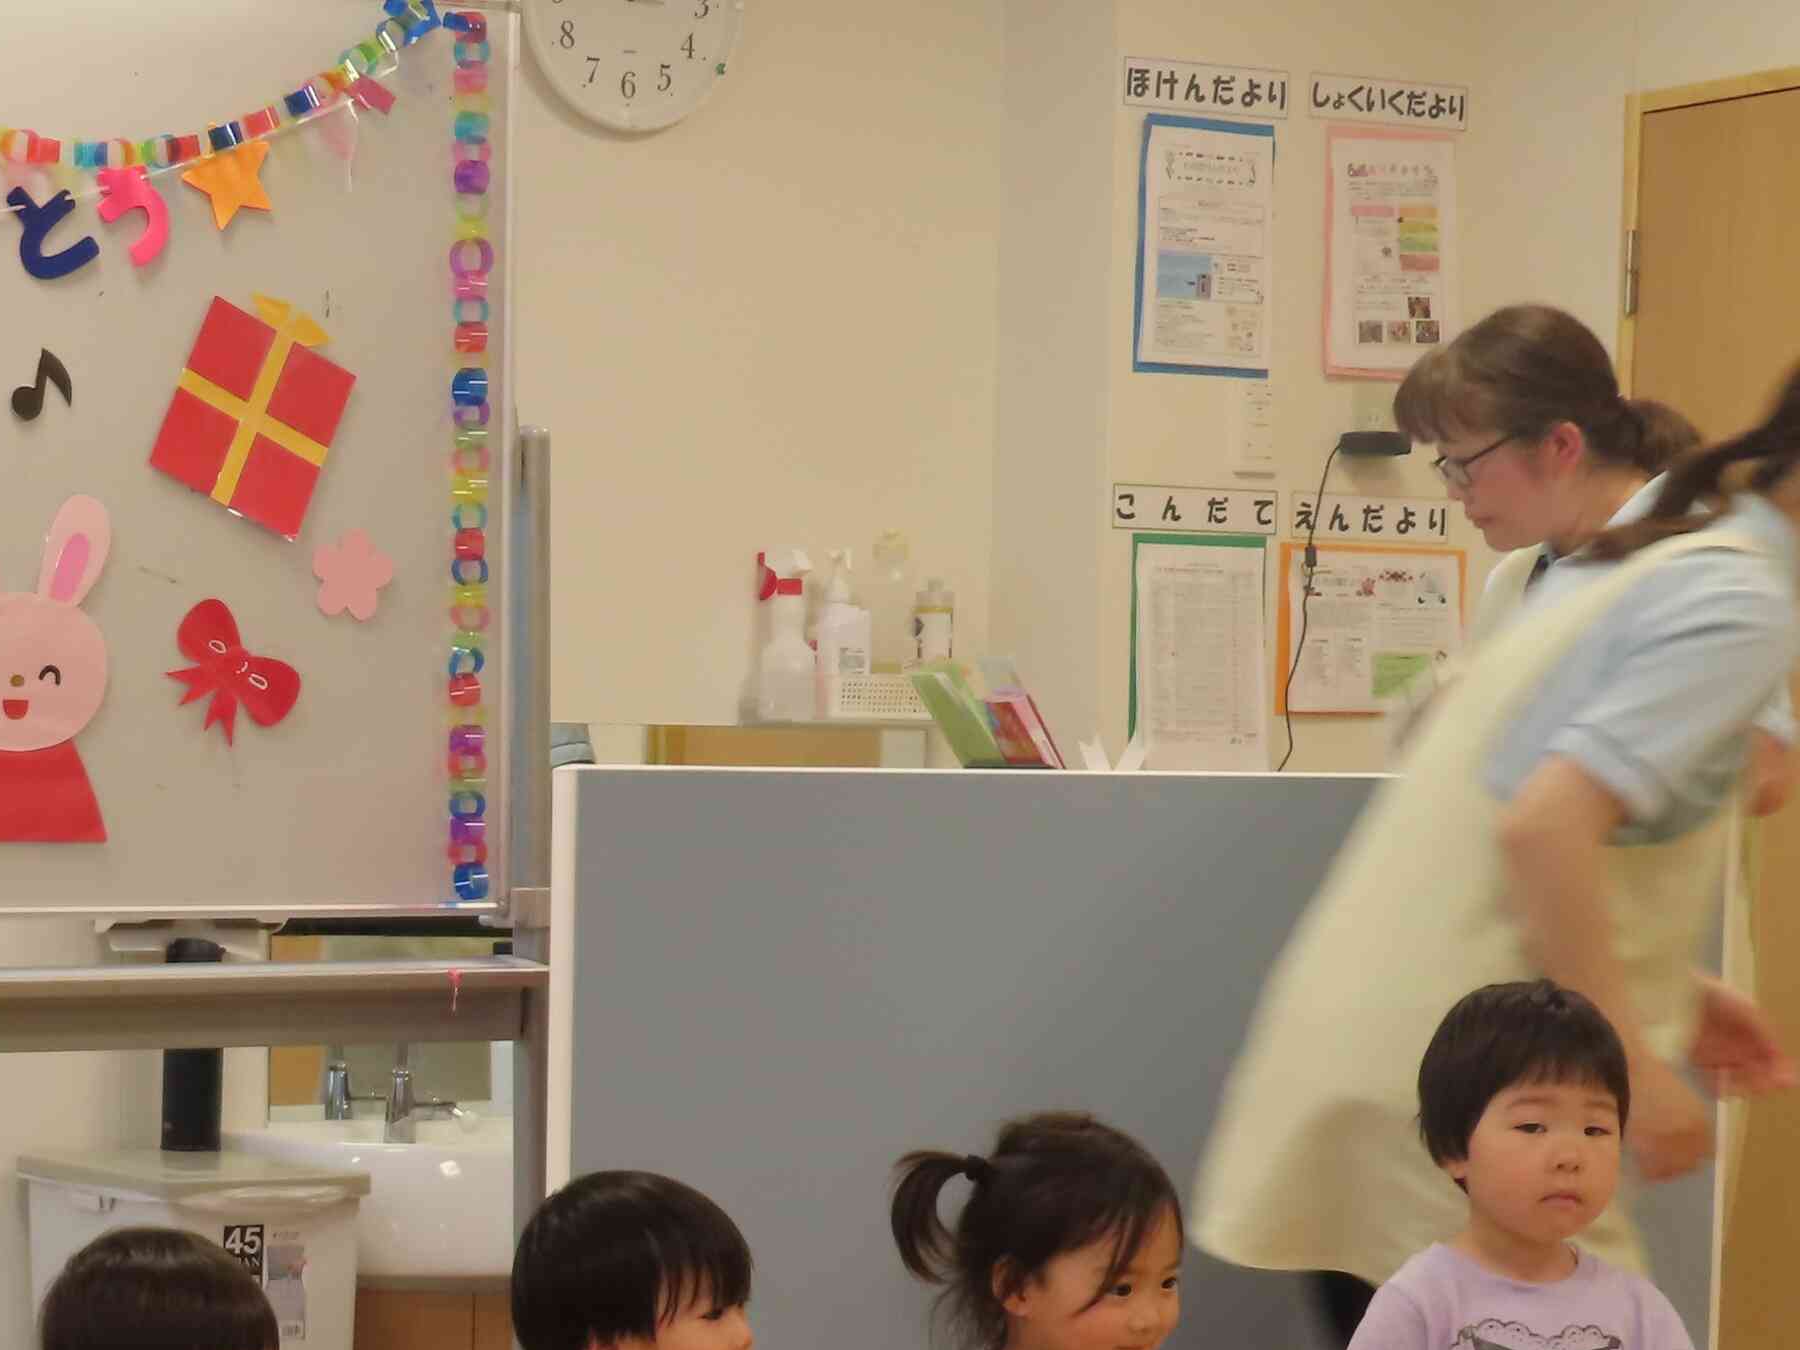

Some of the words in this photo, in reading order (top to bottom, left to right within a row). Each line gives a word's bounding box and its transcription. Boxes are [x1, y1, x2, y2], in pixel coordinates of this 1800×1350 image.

[560, 20, 575, 49] 8
[680, 33, 695, 59] 4
[586, 56, 600, 83] 7
[657, 64, 671, 92] 5
[621, 71, 636, 99] 6
[1126, 67, 1287, 110] ほけんだより
[1312, 81, 1465, 121] しょくいくだより
[1116, 494, 1274, 526] こんだて
[1295, 503, 1446, 536] えんだより
[225, 1227, 261, 1254] 45
